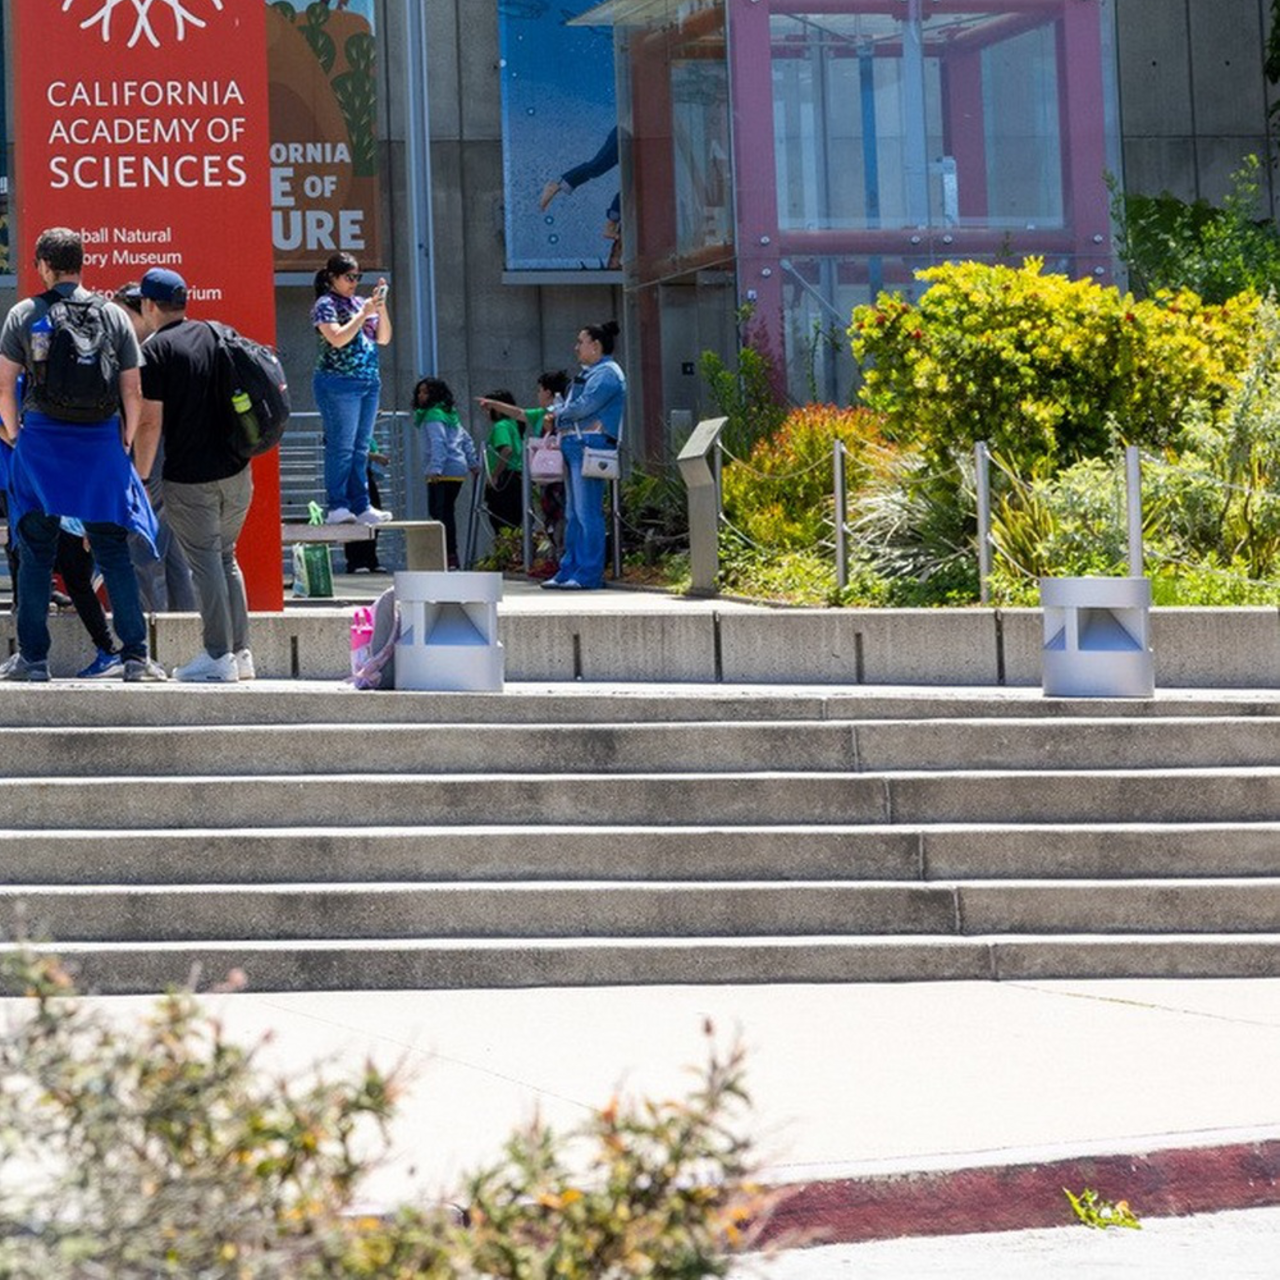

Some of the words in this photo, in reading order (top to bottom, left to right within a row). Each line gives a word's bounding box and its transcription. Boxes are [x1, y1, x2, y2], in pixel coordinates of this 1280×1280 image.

[47, 80, 244, 107] CALIFORNIA
[48, 118, 200, 144] ACADEMY
[207, 118, 246, 143] OF
[269, 142, 351, 163] ORNIA
[49, 155, 247, 189] SCIENCES
[303, 175, 337, 198] OF
[79, 227, 108, 243] ball
[113, 227, 172, 243] Natural
[271, 210, 365, 250] URE
[112, 249, 182, 265] Museum
